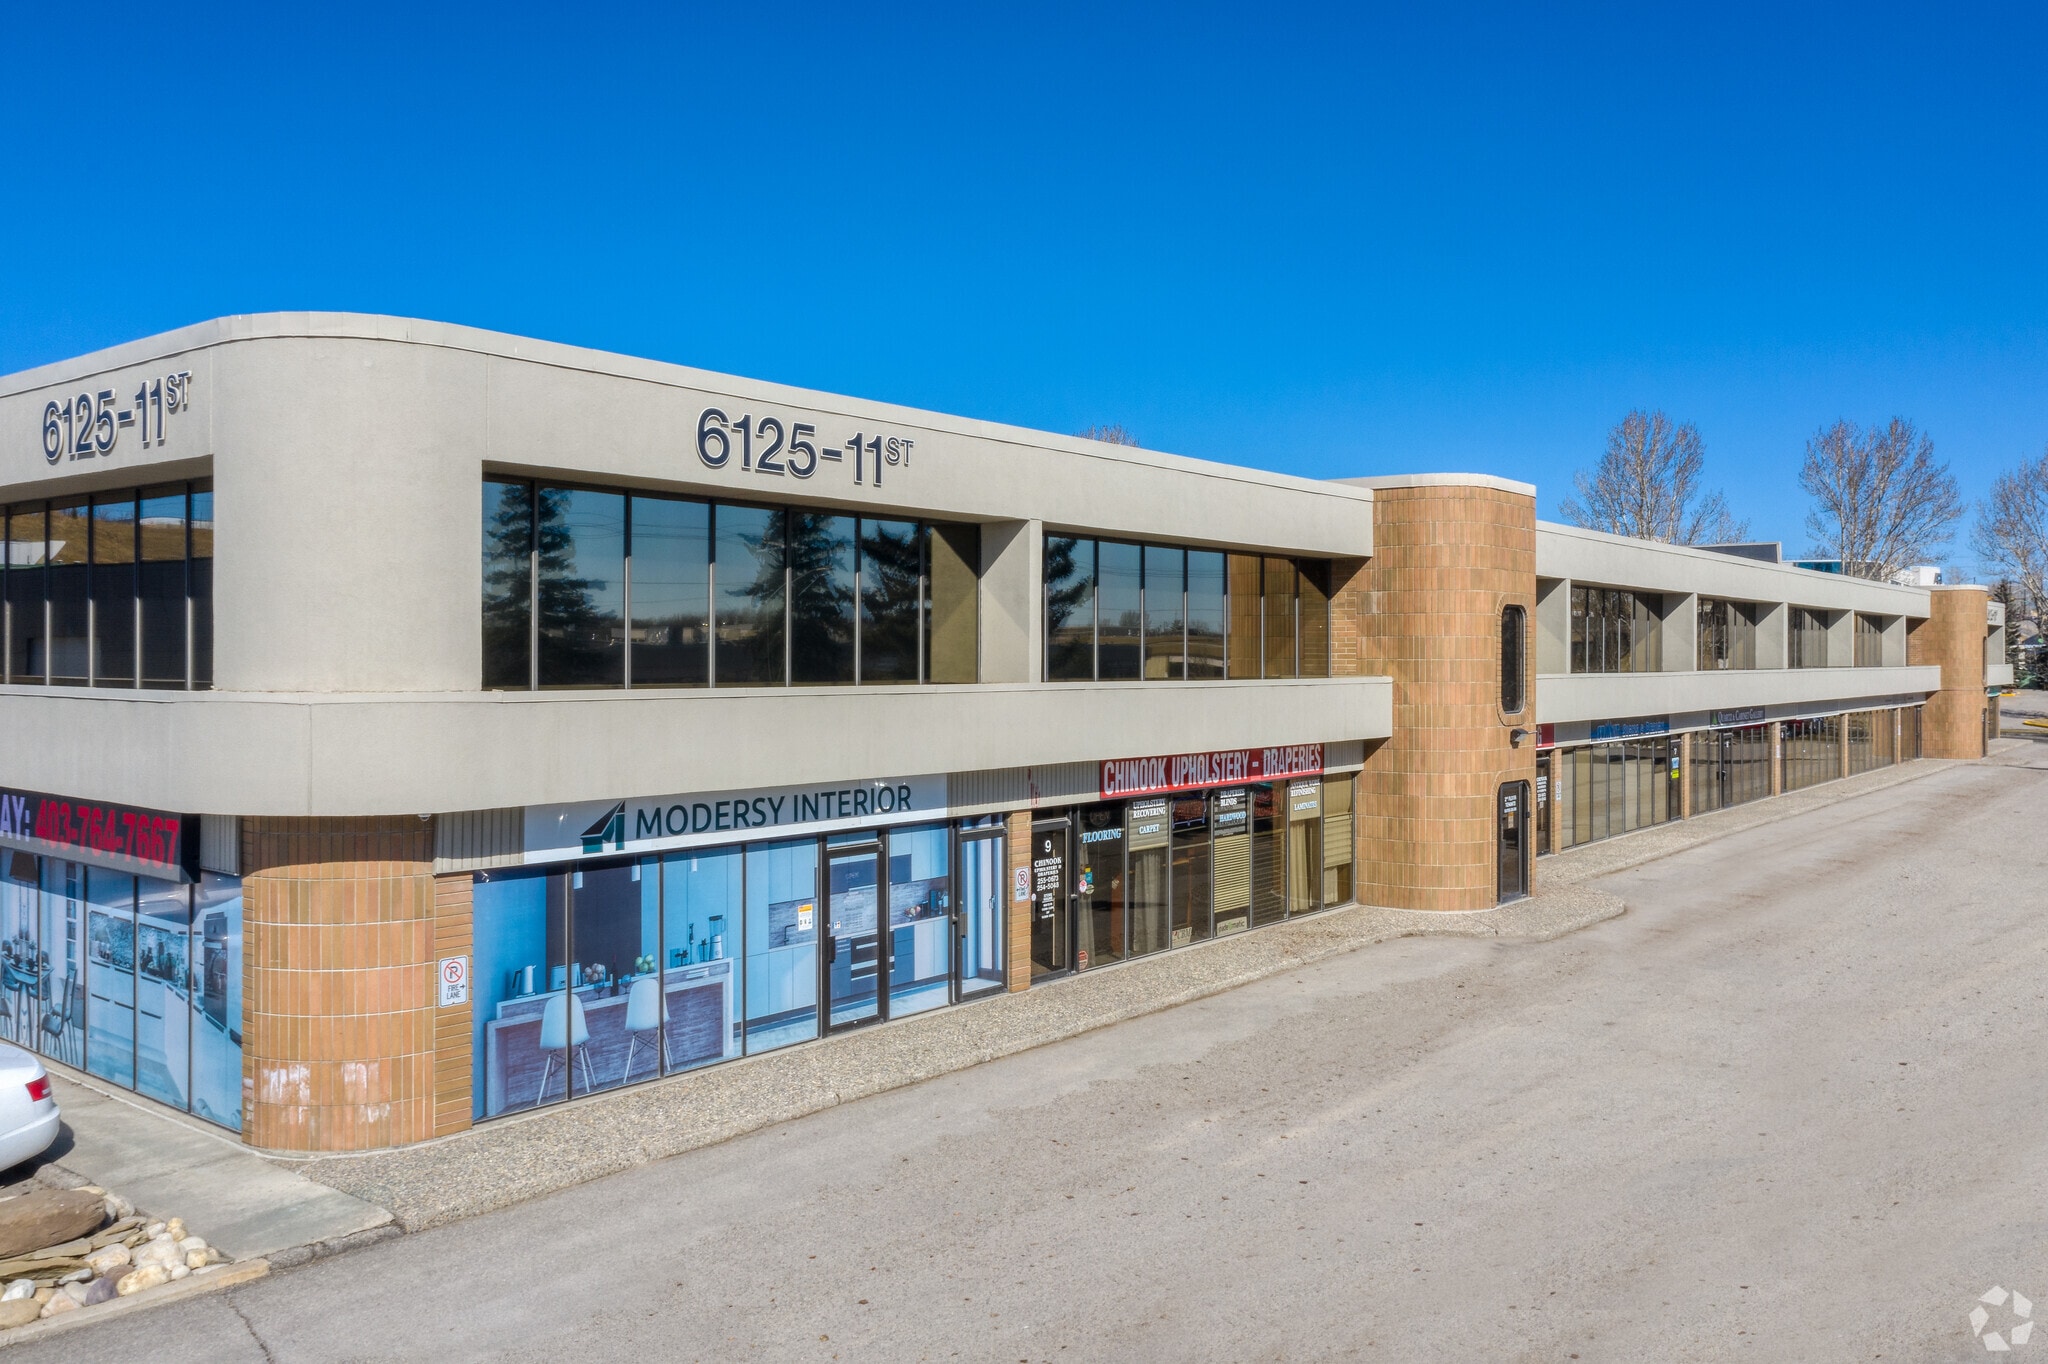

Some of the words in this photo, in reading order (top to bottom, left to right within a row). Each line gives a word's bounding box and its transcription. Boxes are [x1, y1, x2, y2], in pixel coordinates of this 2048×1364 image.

[1103, 756, 1168, 795] CHINOOK
[1172, 751, 1250, 786] UPHOLSTERY
[1263, 744, 1321, 777] DRAPERIES
[1133, 798, 1166, 809] UPHOLSTERY
[1220, 797, 1238, 807] BLINDS
[635, 795, 786, 839] MODERSY
[793, 784, 912, 823] INTERIOR
[1132, 807, 1166, 819] RECOVERING
[34, 799, 180, 871] 403-764-7667
[1139, 823, 1160, 835] CARPET
[1082, 828, 1122, 844] FLOORING
[1045, 839, 1052, 853] 9
[1034, 857, 1062, 868] CHINOOK
[447, 983, 460, 993] FIRE
[446, 990, 461, 1000] LANE
